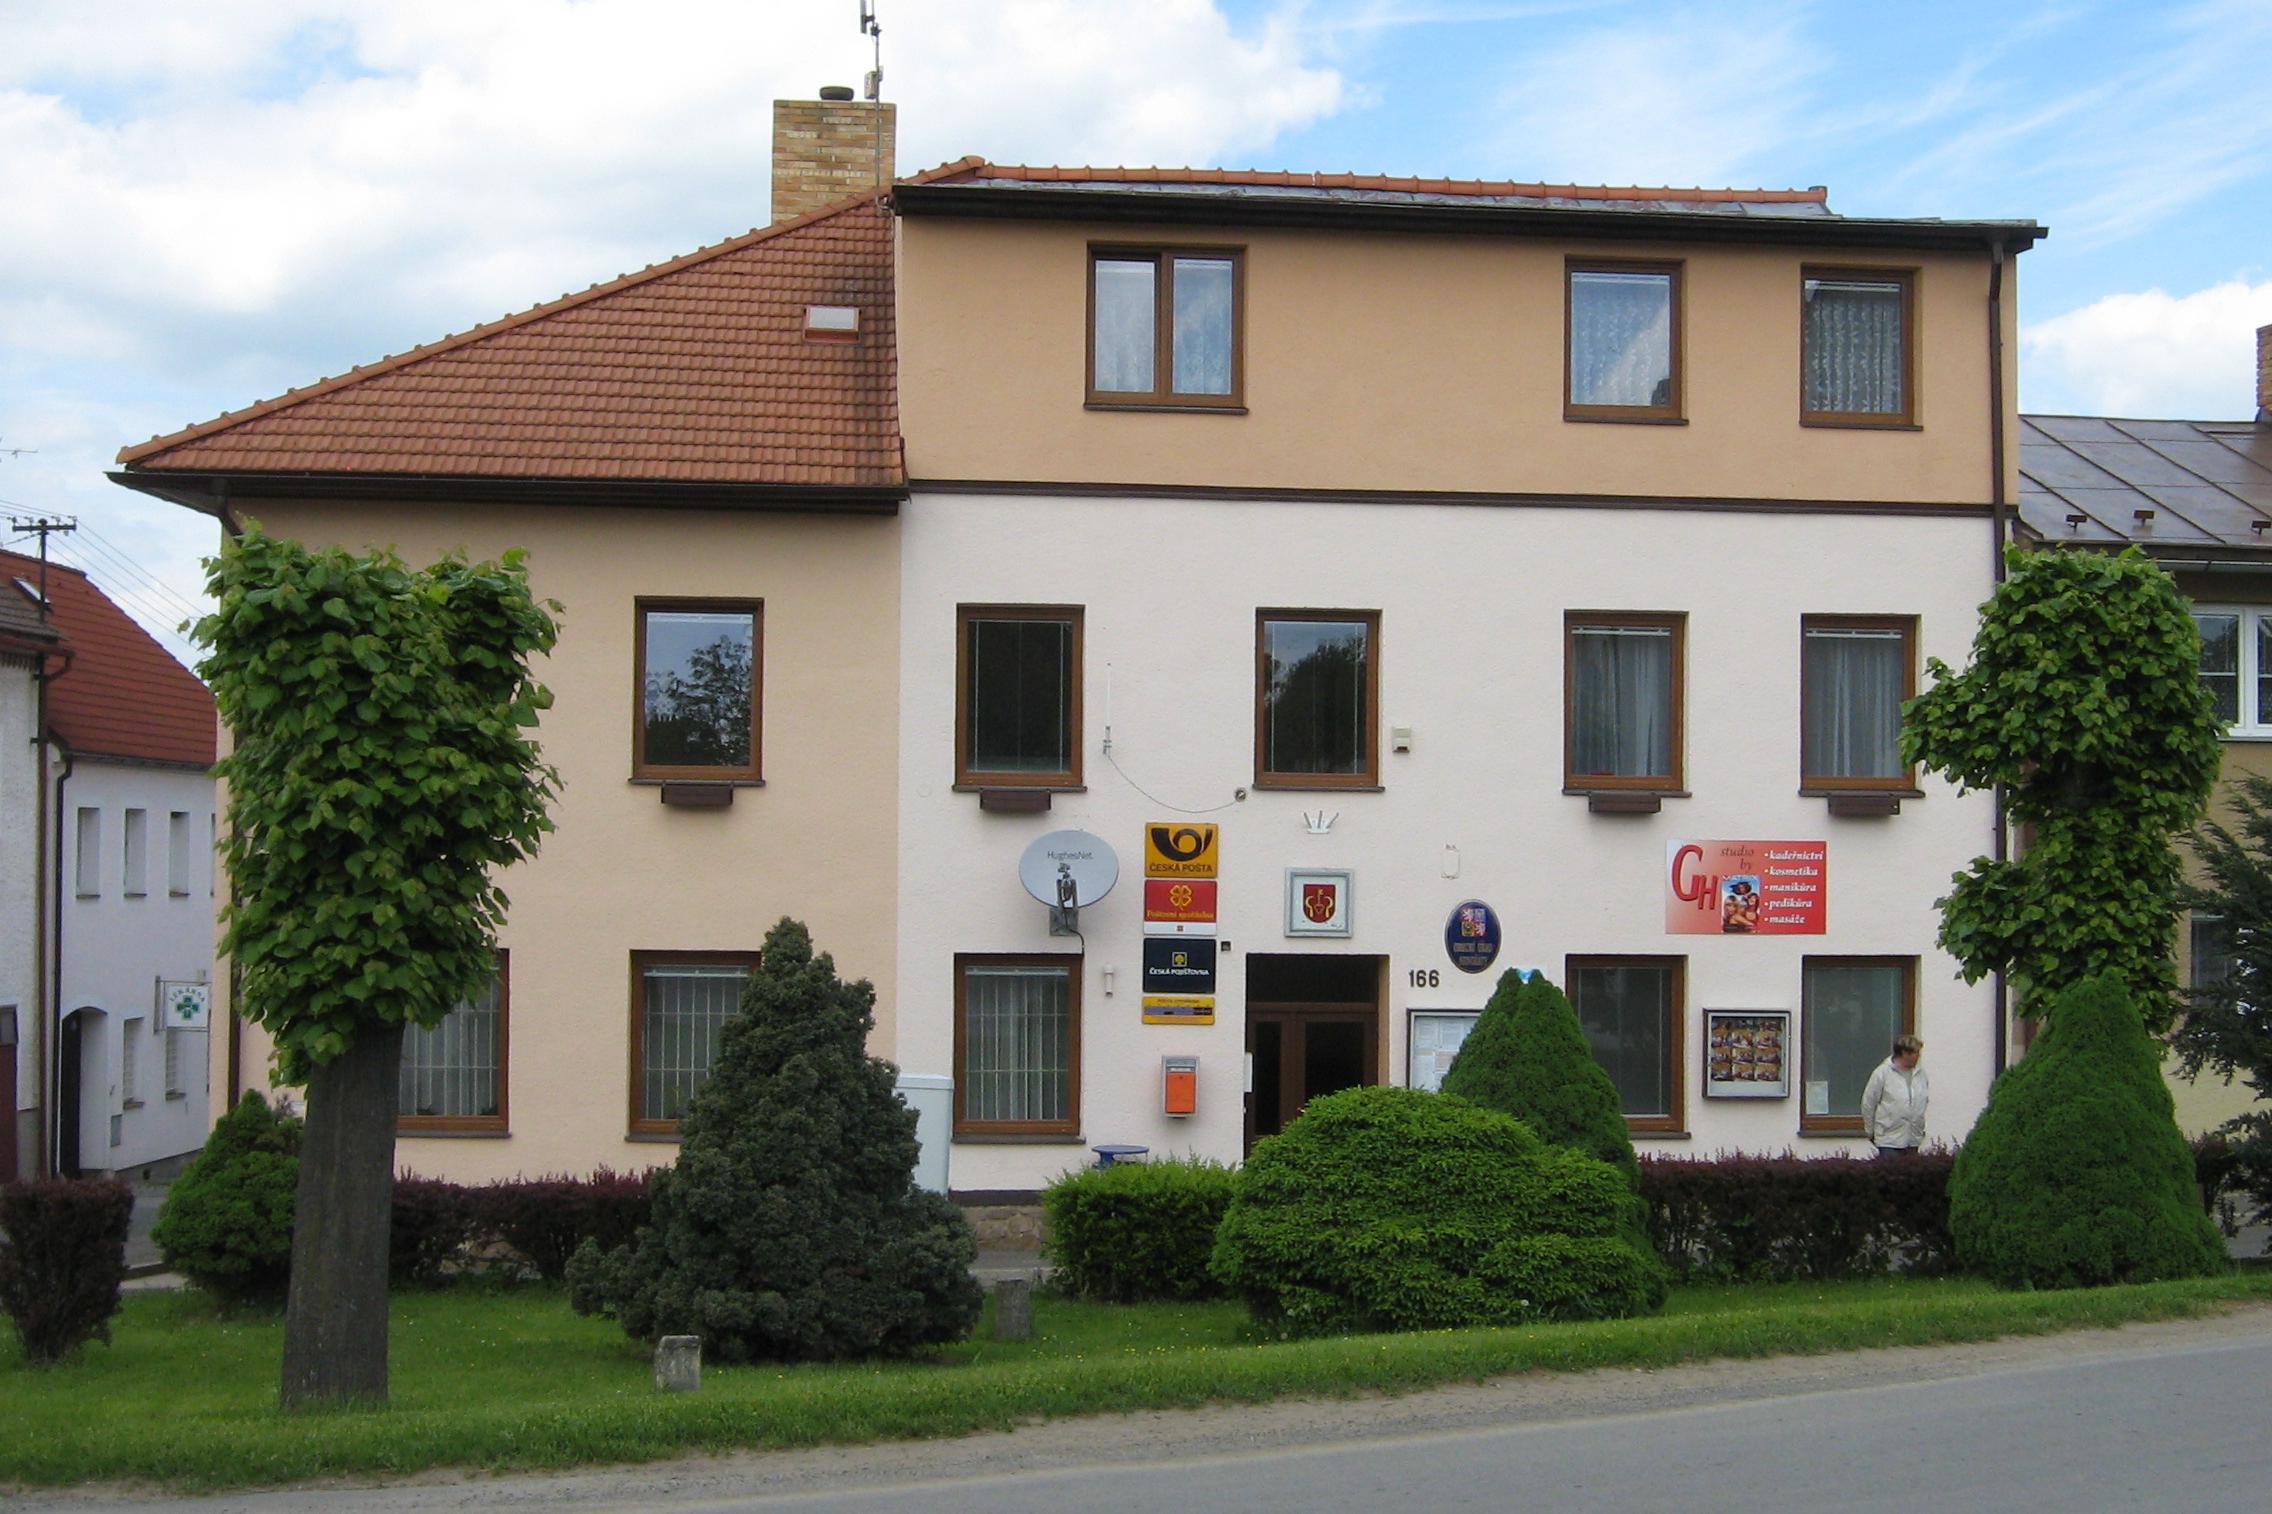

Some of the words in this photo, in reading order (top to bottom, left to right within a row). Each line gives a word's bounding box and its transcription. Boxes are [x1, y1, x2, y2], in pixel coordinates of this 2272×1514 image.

[1720, 845, 1754, 857] studio
[1149, 862, 1180, 873] ČESKÁ
[1182, 863, 1213, 873] POŠTA
[1740, 858, 1752, 871] by
[1769, 866, 1818, 876] kosmetika
[1769, 914, 1806, 924] masáže
[1409, 969, 1440, 988] 166
